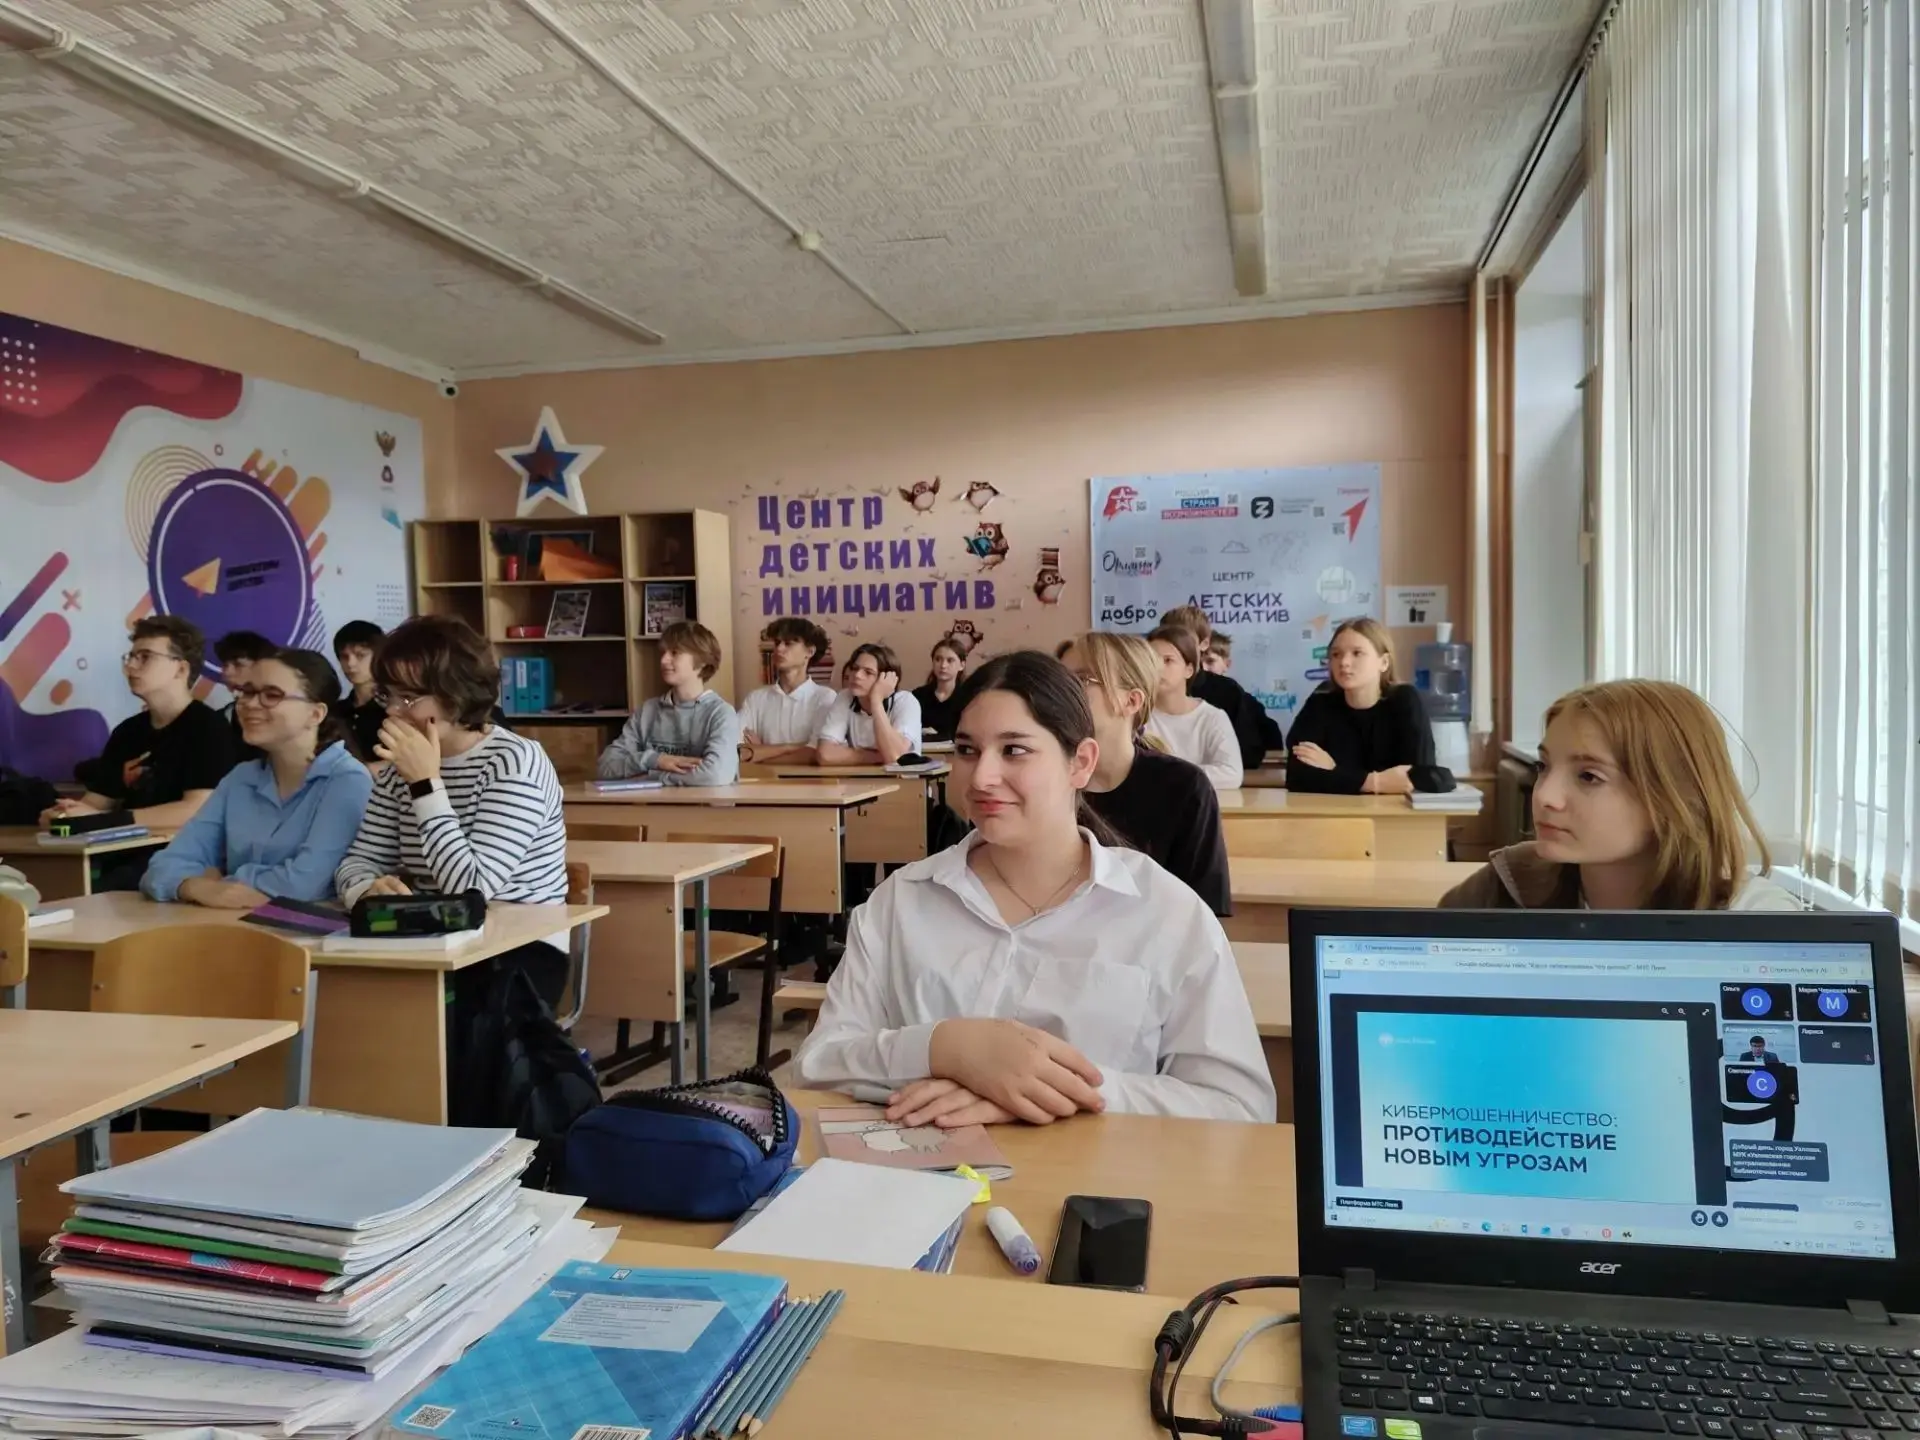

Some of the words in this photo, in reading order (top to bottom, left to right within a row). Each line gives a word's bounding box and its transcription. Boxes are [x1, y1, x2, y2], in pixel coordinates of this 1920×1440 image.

[758, 495, 883, 536] Центр
[1183, 499, 1217, 508] СТРАНА
[759, 538, 936, 579] детских
[1212, 571, 1255, 582] ЦЕНТР
[762, 580, 996, 618] инициатив
[1101, 604, 1157, 622] добро
[1382, 1104, 1618, 1128] КИБЕРМОШЕННИЧЕСТВО:
[1383, 1124, 1617, 1151] ПРОТИВОДЕЙСТВИЕ
[1384, 1147, 1470, 1167] НОВЫМ
[1476, 1151, 1588, 1173] УГРОЗАМ
[1580, 1261, 1622, 1275] acer
